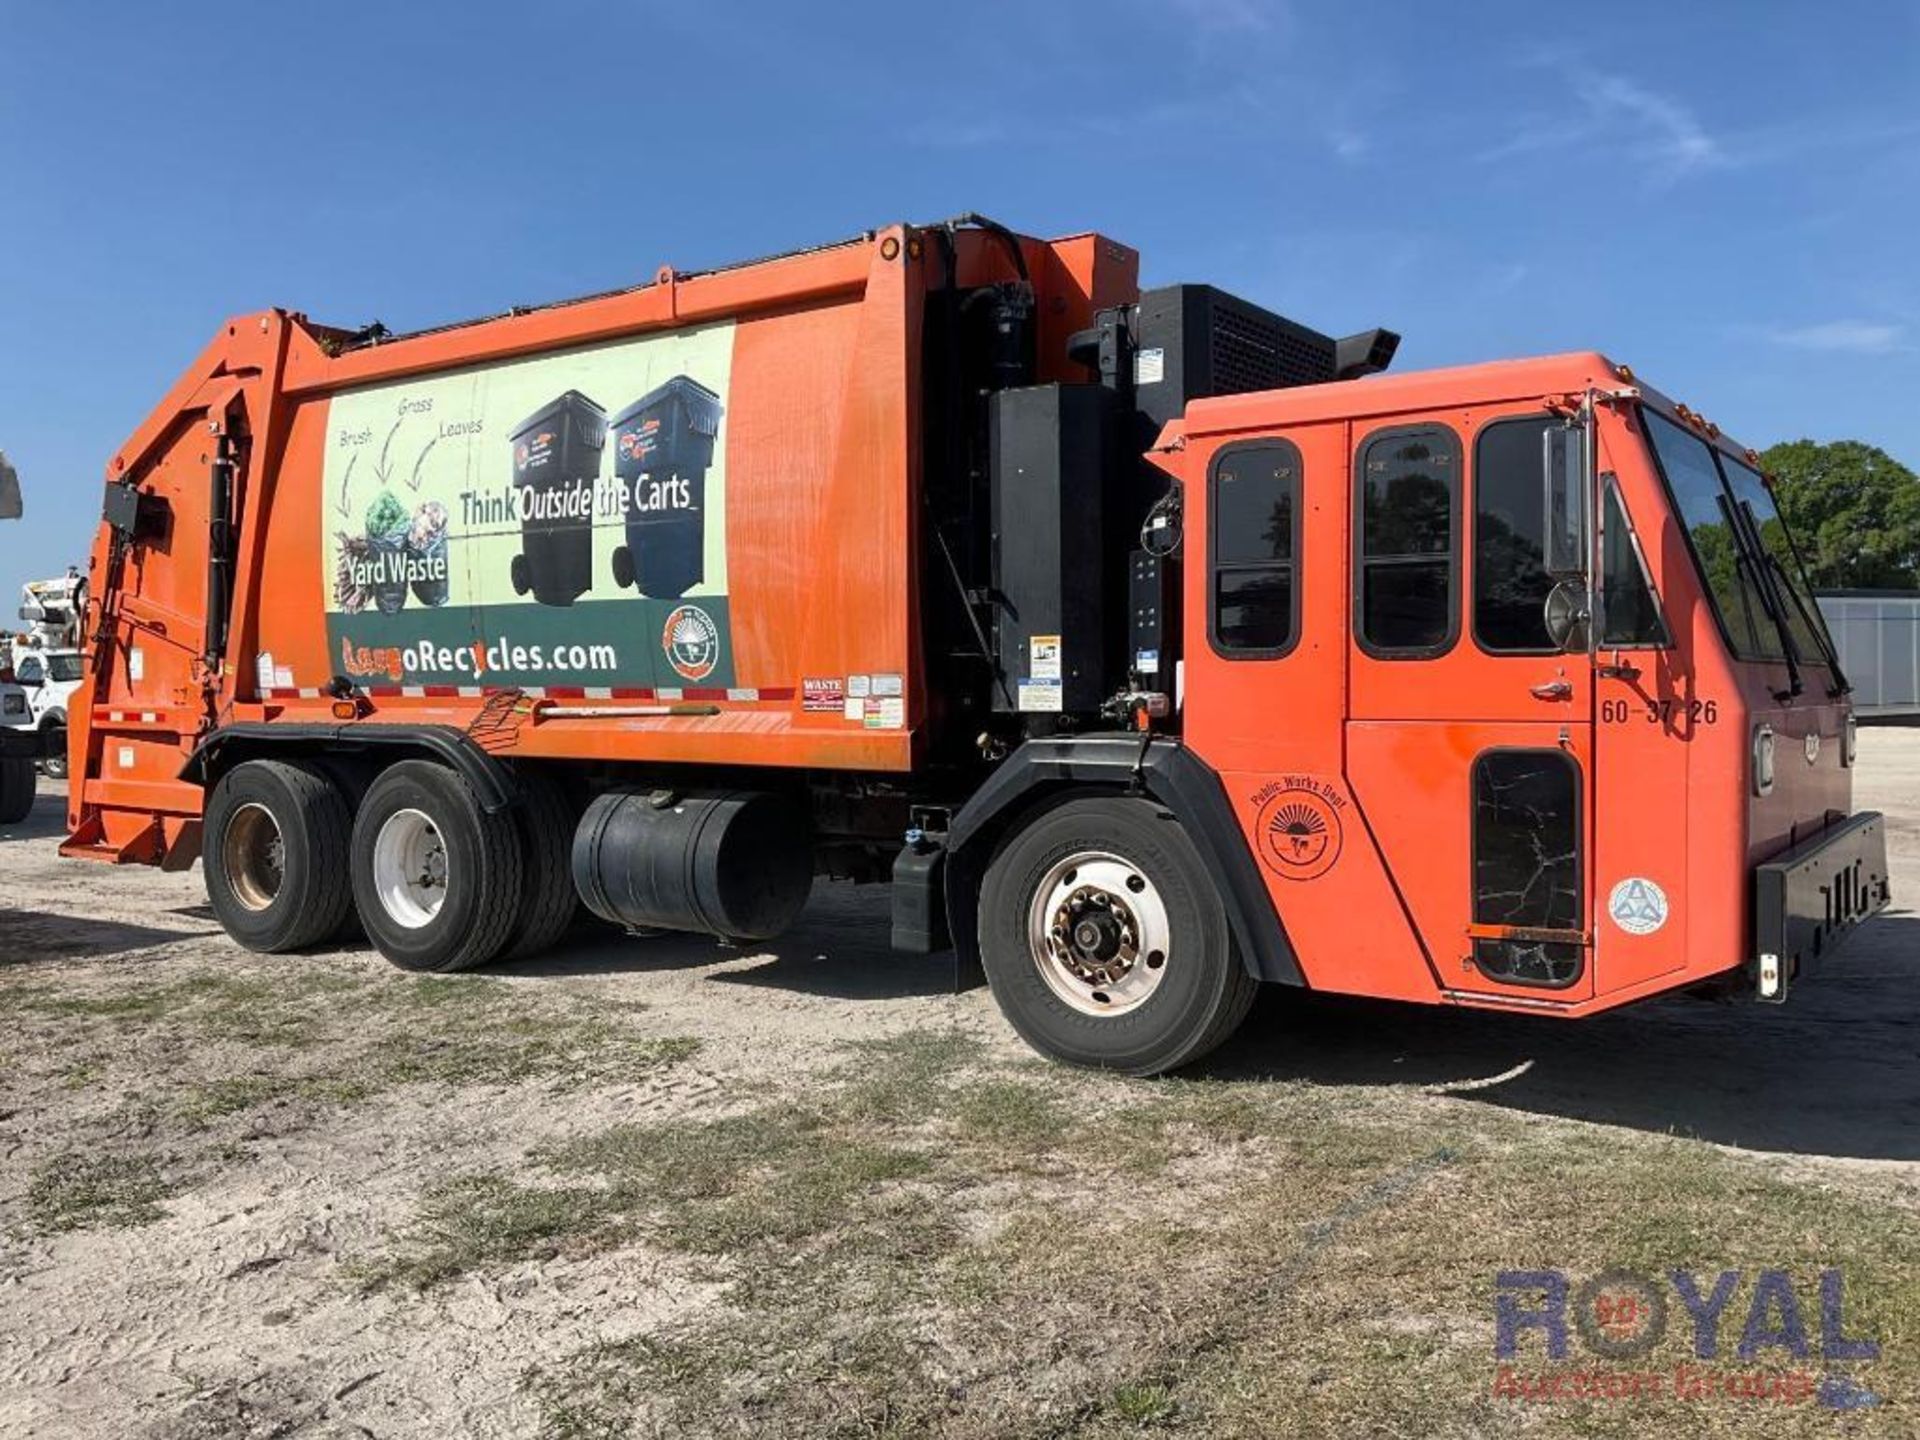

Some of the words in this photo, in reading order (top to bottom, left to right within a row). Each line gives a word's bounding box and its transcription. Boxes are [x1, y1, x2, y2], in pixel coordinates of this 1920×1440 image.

[439, 419, 483, 439] Leaves
[460, 486, 516, 525] Think
[521, 478, 591, 521] Outside
[598, 476, 630, 516] the
[635, 473, 690, 512] Carts
[346, 552, 386, 585] Yard
[387, 552, 446, 583] Waste
[803, 679, 842, 691] WASTE
[1250, 781, 1282, 806] Public
[1284, 775, 1319, 790] Works
